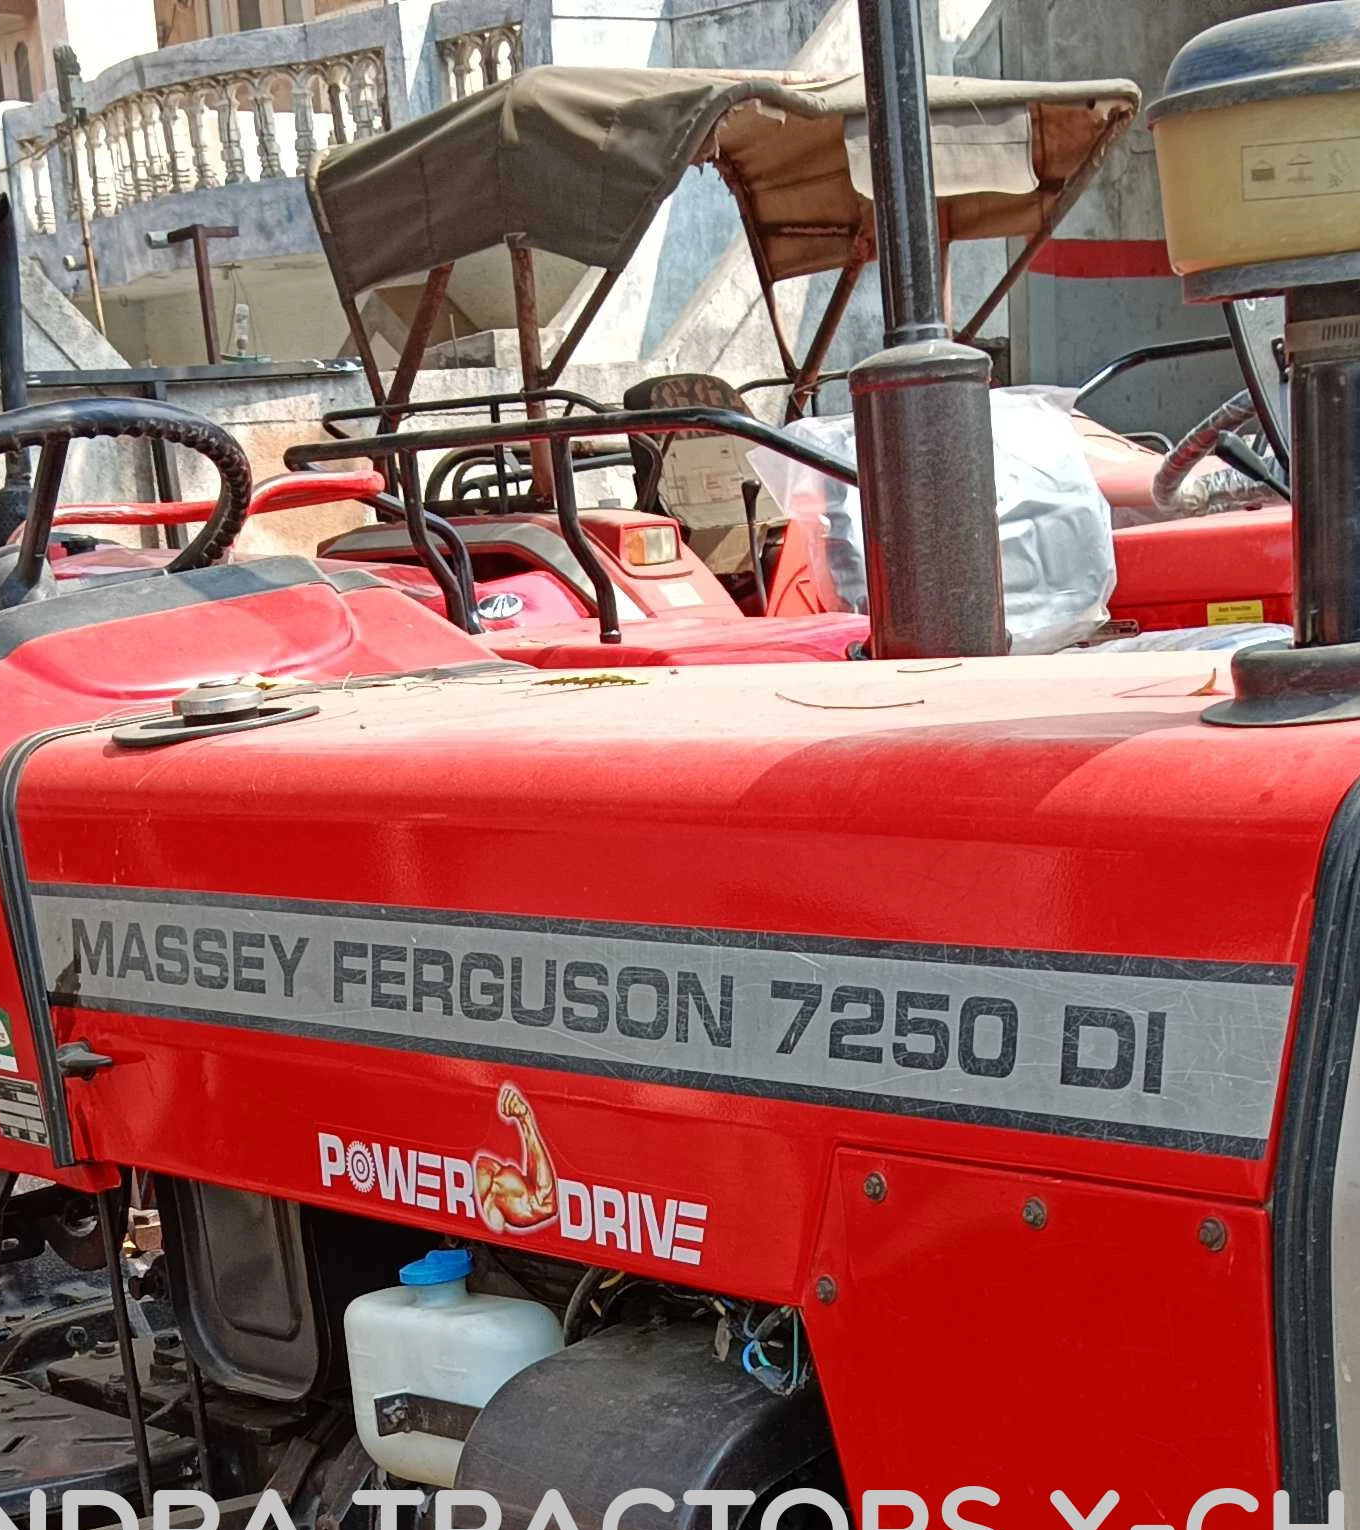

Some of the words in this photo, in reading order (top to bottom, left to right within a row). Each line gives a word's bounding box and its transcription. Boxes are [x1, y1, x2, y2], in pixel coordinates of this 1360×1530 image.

[71, 917, 310, 998] MASSEY
[332, 939, 735, 1050] FERGUSON
[770, 979, 1020, 1079] 7250
[1059, 1004, 1168, 1095] DI
[317, 1131, 477, 1219] POWER
[556, 1177, 709, 1266] DRIVE
